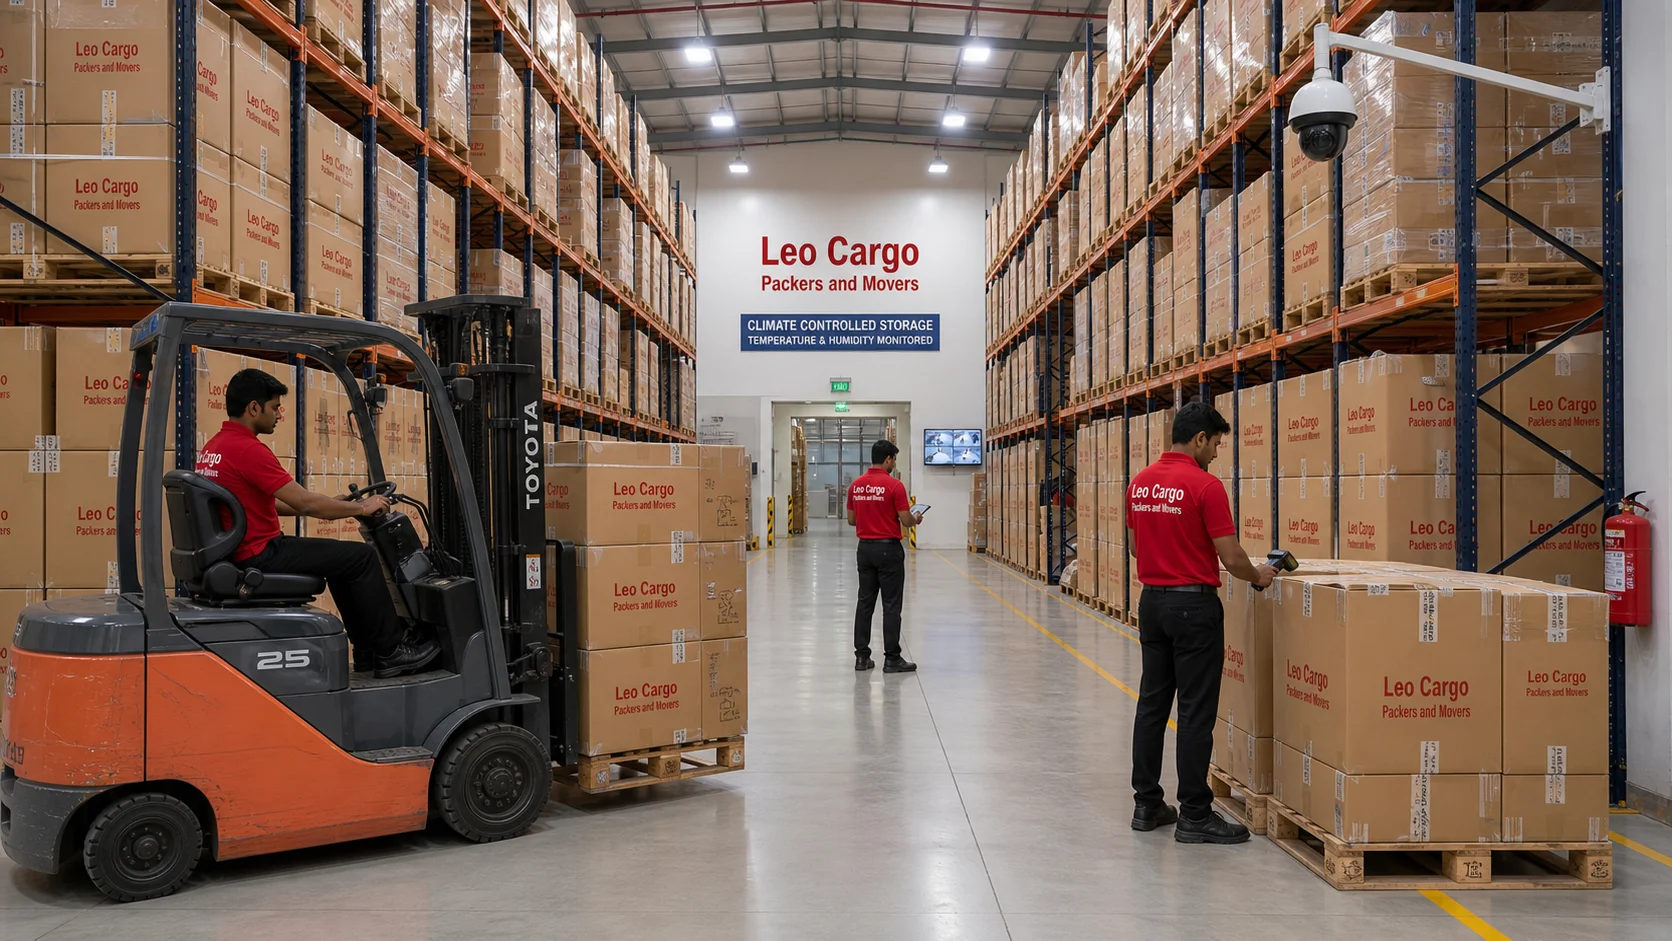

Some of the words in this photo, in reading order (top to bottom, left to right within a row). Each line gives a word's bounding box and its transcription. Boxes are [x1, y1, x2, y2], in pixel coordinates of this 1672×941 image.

[76, 41, 99, 56] Leo
[102, 40, 139, 60] Cargo
[102, 62, 115, 73] and
[247, 90, 260, 109] Leo
[76, 178, 98, 194] Leo
[102, 178, 139, 198] Cargo
[102, 199, 115, 210] and
[198, 189, 218, 213] Cargo
[247, 209, 260, 227] Leo
[260, 215, 280, 237] Cargo
[761, 236, 818, 266] Leo
[828, 235, 920, 274] Cargo
[761, 275, 824, 292] Packers
[829, 275, 858, 292] and
[863, 275, 920, 292] Movers
[747, 319, 798, 331] CLIMATE
[800, 319, 877, 331] CONTROLLED
[880, 319, 934, 331] STORAGE
[748, 335, 817, 345] TEMPERATURE
[819, 335, 826, 345] &
[829, 335, 874, 345] HUMIDITY
[877, 335, 934, 345] MONITORED
[85, 376, 109, 391] Leo
[1410, 397, 1434, 412] Leo
[1529, 397, 1553, 412] Leo
[1558, 396, 1597, 415] Cargo
[1438, 417, 1452, 427] and
[1558, 416, 1572, 427] and
[524, 400, 540, 510] TOYOTA
[547, 482, 569, 499] Cargo
[614, 481, 637, 496] Leo
[640, 481, 676, 499] Cargo
[866, 484, 886, 496] Cargo
[1131, 483, 1149, 499] Leo
[1152, 483, 1184, 504] Cargo
[78, 506, 102, 521] Leo
[640, 500, 653, 510] and
[1410, 520, 1434, 535] Leo
[1438, 539, 1453, 550] and
[1558, 540, 1572, 550] and
[614, 583, 638, 597] Leo
[641, 581, 676, 598] Cargo
[641, 600, 653, 610] and
[257, 650, 311, 671] 25
[1286, 658, 1302, 681] Leo
[1303, 663, 1329, 692] Cargo
[1528, 670, 1549, 683] Leo
[1552, 669, 1587, 686] Cargo
[616, 686, 639, 701] Leo
[642, 683, 678, 699] Cargo
[1384, 676, 1415, 697] Leo
[1420, 676, 1469, 702] Cargo
[642, 702, 655, 713] and
[1382, 704, 1418, 718] Packers
[1419, 704, 1437, 718] and
[1439, 704, 1471, 718] Movers
